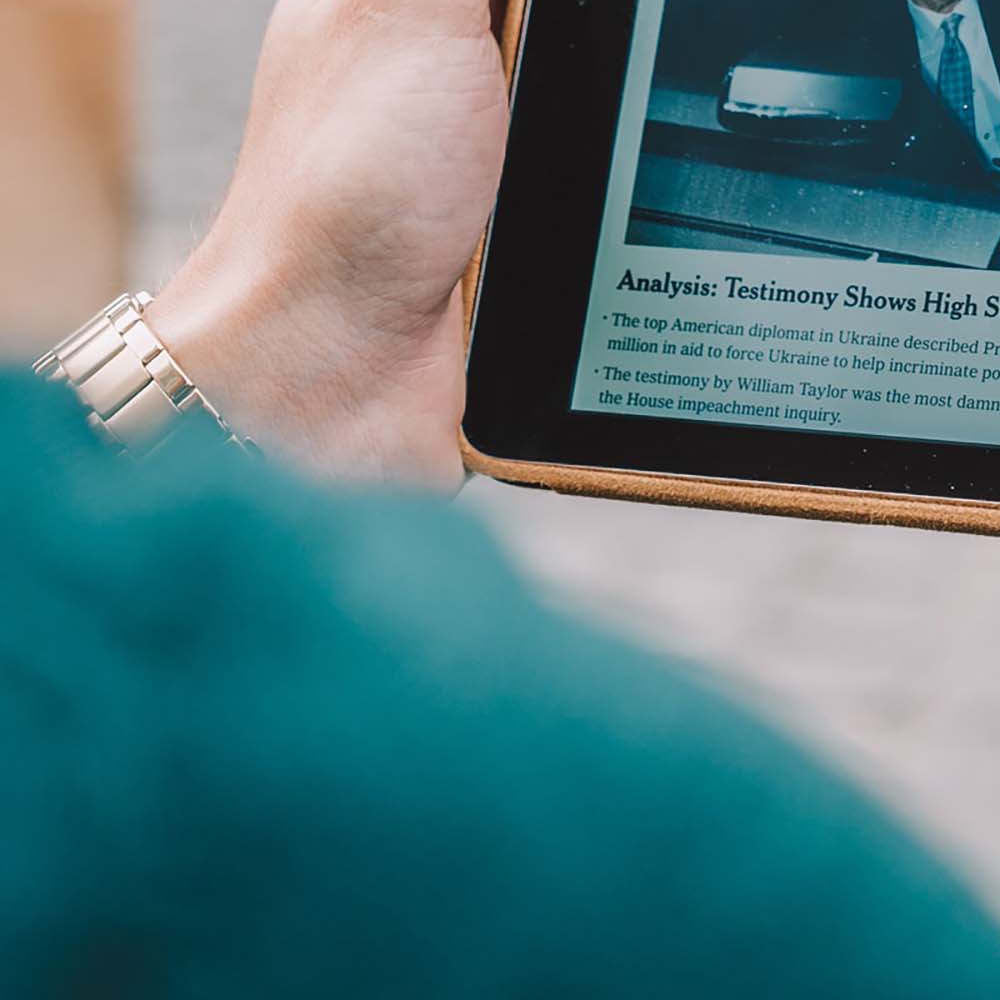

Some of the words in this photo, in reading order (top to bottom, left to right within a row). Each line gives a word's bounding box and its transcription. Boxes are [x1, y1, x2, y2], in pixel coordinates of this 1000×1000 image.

[616, 269, 717, 298] Analysis:
[725, 276, 839, 311] Testimony
[843, 285, 916, 312] Shows
[922, 291, 977, 320] High
[611, 312, 640, 328] The
[644, 317, 667, 332] top
[671, 318, 744, 336] American
[748, 323, 814, 342] diplomat
[819, 327, 833, 342] in
[838, 330, 899, 348] Ukraine
[903, 335, 978, 354] described
[607, 337, 658, 353] million
[662, 340, 676, 354] in
[680, 341, 704, 357] aid
[707, 344, 722, 358] to
[726, 343, 764, 361] force
[768, 349, 829, 367] Ukraine
[833, 353, 848, 368] to
[852, 355, 885, 373] help
[889, 358, 977, 378] incriminate
[599, 390, 623, 404] the
[626, 392, 673, 409] House
[677, 395, 780, 418] impeachment
[784, 403, 842, 424] inquiry.
[603, 366, 631, 381] The
[635, 370, 709, 390] testimony
[713, 374, 732, 392] by
[737, 376, 794, 395] William
[799, 381, 848, 400] Taylor
[852, 388, 882, 401] was
[885, 389, 910, 404] the
[914, 393, 952, 408] most
